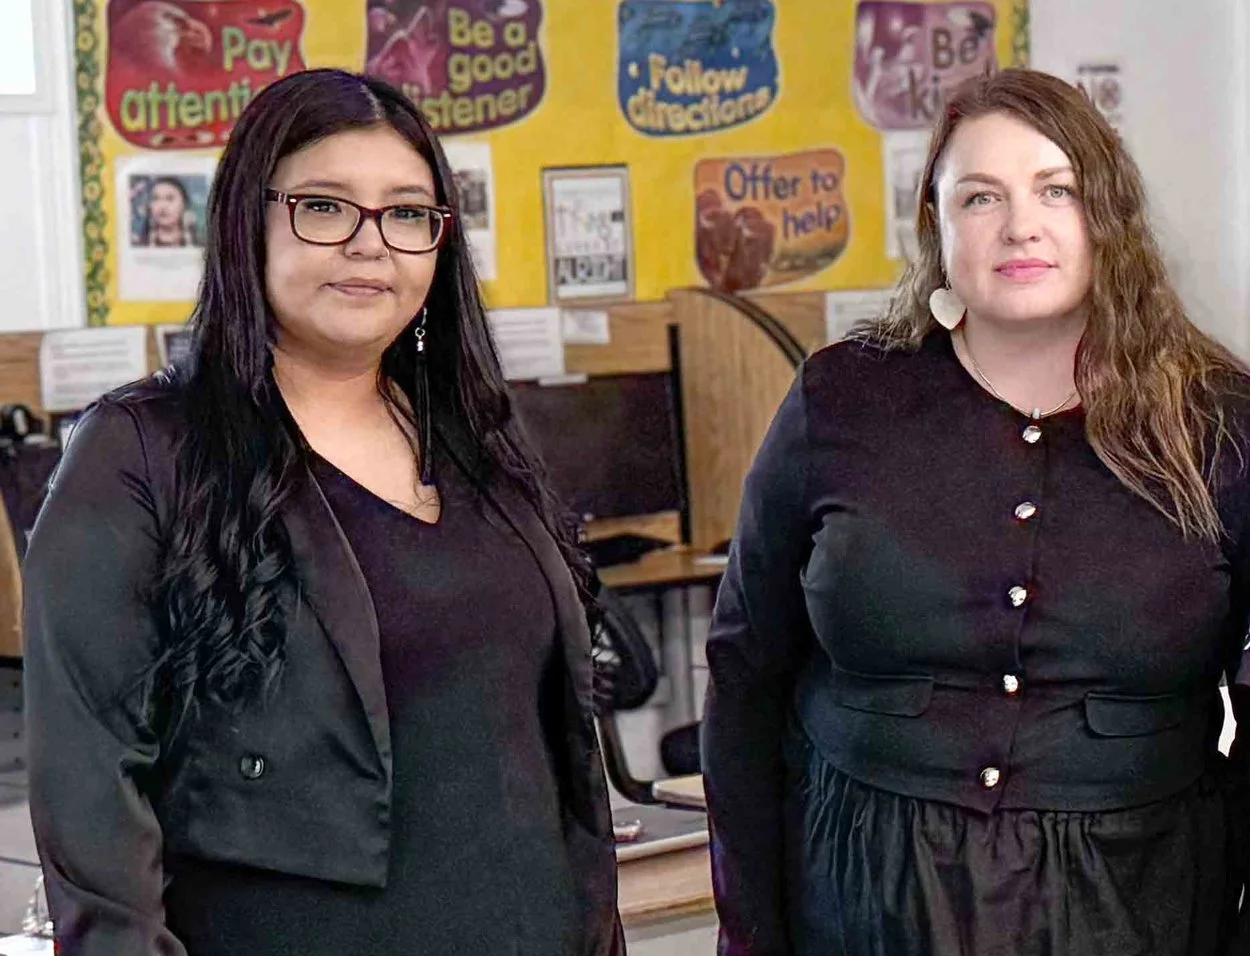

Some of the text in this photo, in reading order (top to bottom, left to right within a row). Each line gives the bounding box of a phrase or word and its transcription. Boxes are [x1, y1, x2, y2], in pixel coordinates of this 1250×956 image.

[450, 8, 526, 47] Be a
[934, 28, 978, 68] Be
[221, 26, 291, 76] Pay
[449, 41, 537, 93] good
[649, 53, 748, 95] Follow
[120, 76, 266, 132] attenti
[628, 86, 771, 131] directions
[724, 163, 837, 200] Offer to
[783, 201, 841, 240] help
